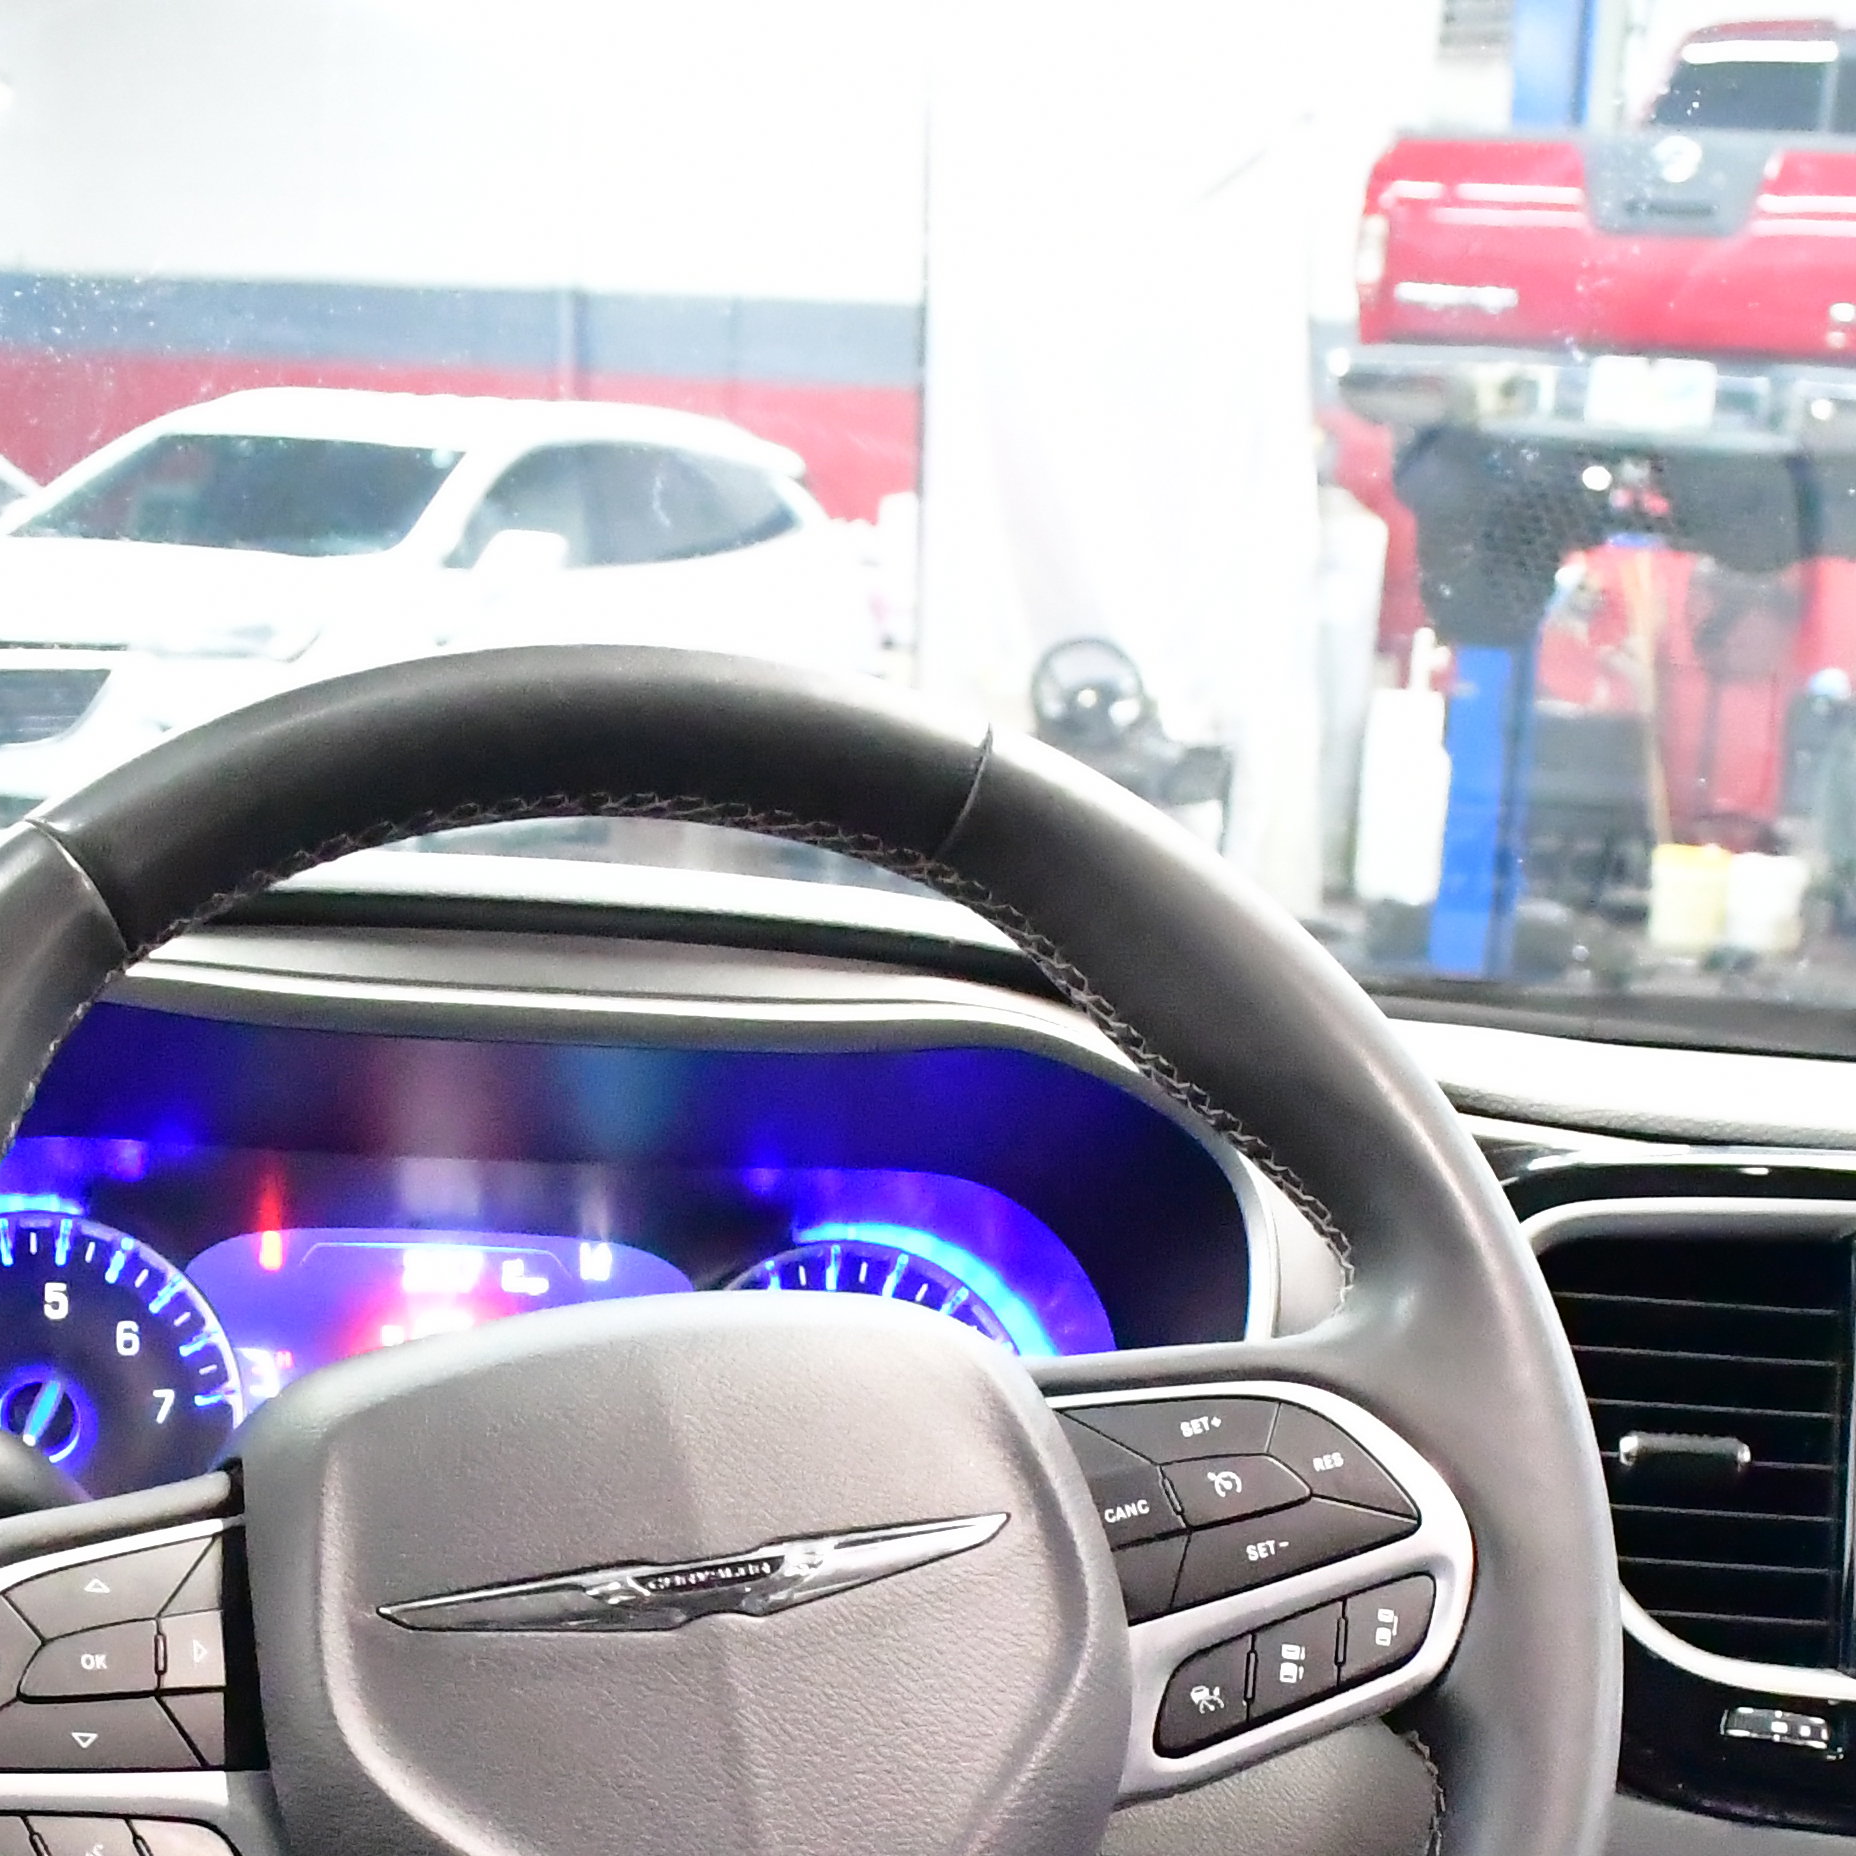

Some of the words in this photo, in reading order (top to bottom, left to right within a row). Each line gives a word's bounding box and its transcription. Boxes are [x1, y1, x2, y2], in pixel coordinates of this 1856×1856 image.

[43, 1281, 69, 1320] 5
[116, 1320, 140, 1356] 6
[152, 1388, 175, 1424] 7
[1312, 1452, 1345, 1472] RES
[1103, 1499, 1150, 1525] CANC
[80, 1653, 108, 1671] OK
